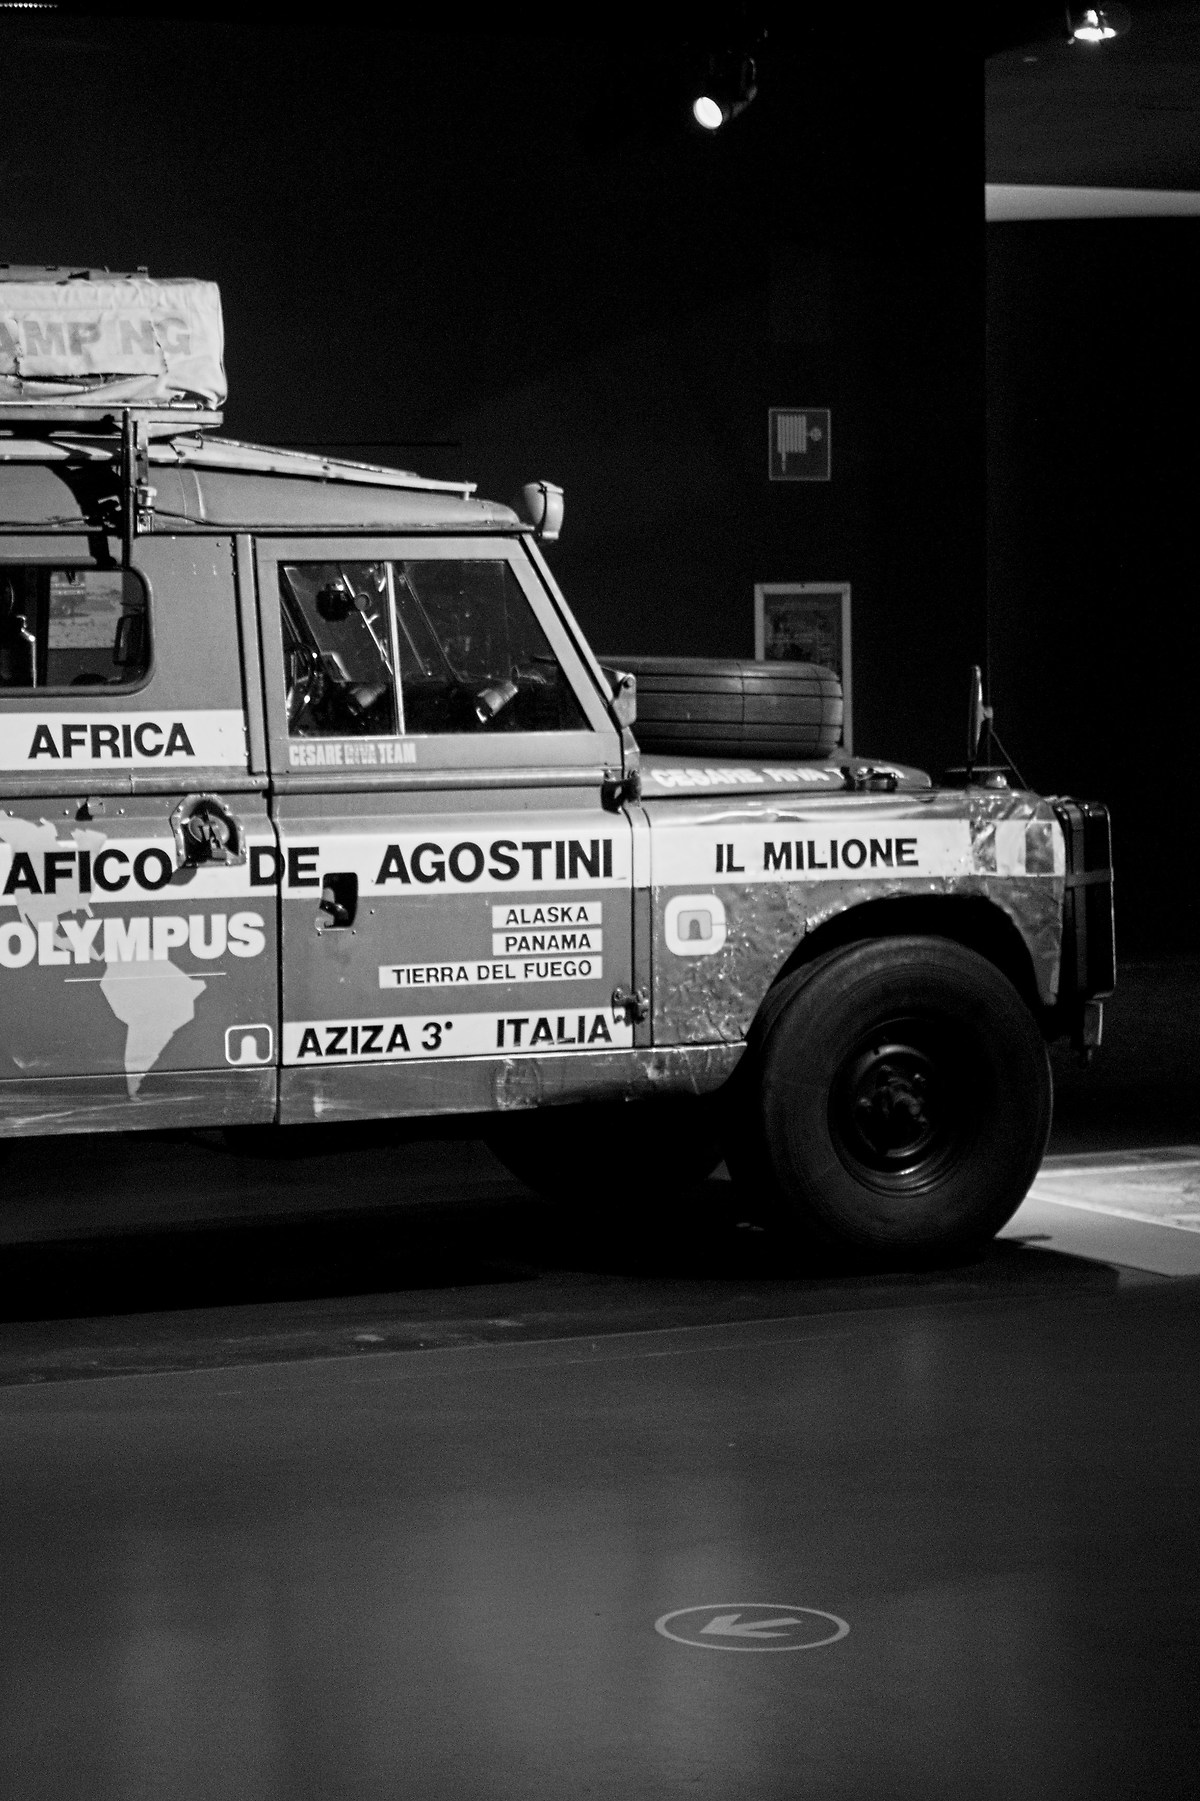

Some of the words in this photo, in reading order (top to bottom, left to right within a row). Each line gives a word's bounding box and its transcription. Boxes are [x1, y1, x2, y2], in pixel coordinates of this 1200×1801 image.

[27, 722, 196, 760] AFRICA
[289, 744, 343, 766] CESARE
[377, 742, 417, 764] TEAM
[249, 846, 320, 888] DE
[375, 838, 613, 885] AGOSTINI
[715, 844, 745, 873] IL
[763, 838, 919, 871] MILIONE
[505, 905, 590, 926] ALASKA
[505, 933, 591, 953] PANAMA
[392, 965, 469, 985] TIERRA
[477, 963, 516, 981] DEL
[524, 959, 592, 979] FUEGO
[297, 1023, 411, 1058] AZIZA
[496, 1014, 613, 1048] ITALIA
